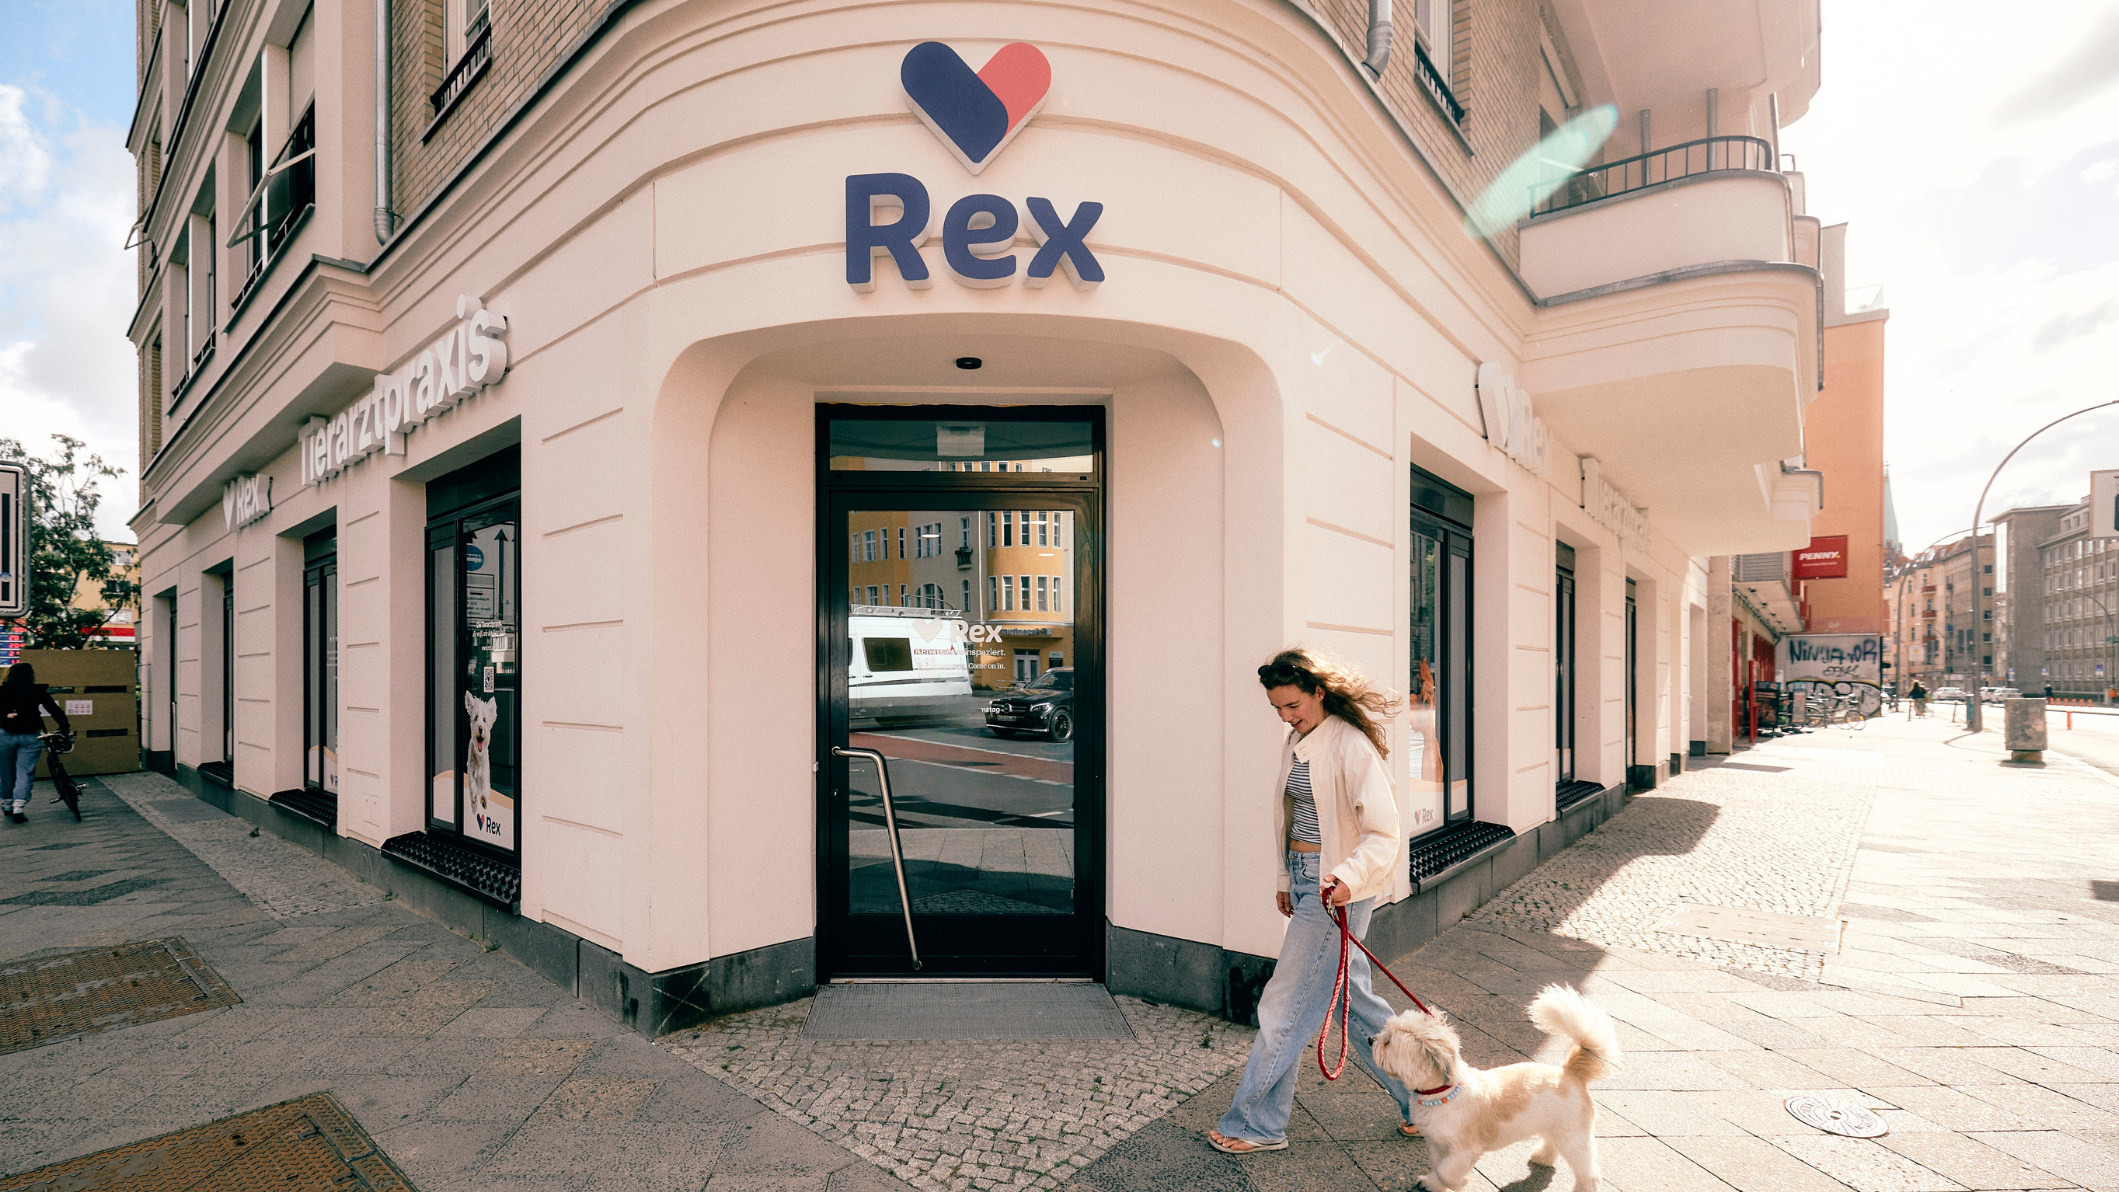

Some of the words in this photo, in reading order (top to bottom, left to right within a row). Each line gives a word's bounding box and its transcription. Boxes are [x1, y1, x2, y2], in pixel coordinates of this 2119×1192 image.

[846, 173, 1105, 286] Rex
[298, 294, 507, 486] Tierarztpraxis
[236, 474, 269, 525] Rex
[951, 619, 1003, 643] Rex
[968, 662, 987, 670] Come
[997, 662, 1006, 670] in.
[486, 816, 501, 836] Rex
[1422, 808, 1433, 824] Rex
